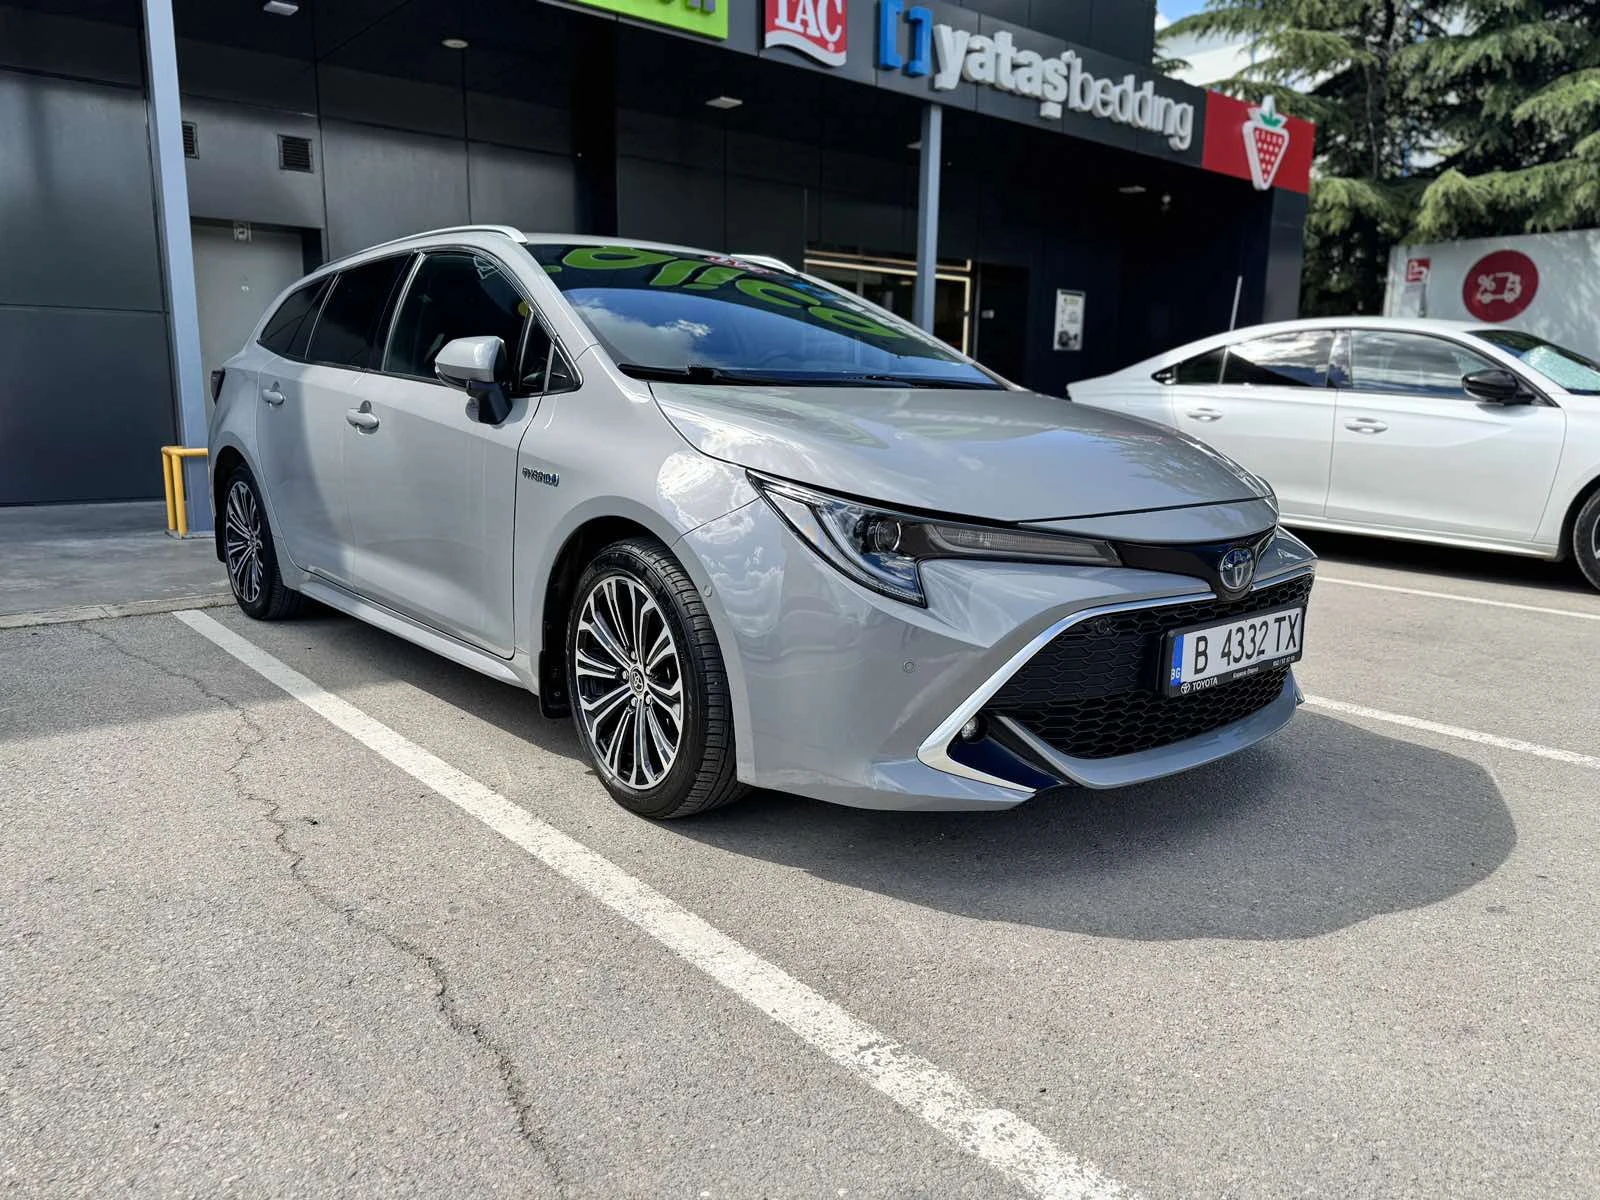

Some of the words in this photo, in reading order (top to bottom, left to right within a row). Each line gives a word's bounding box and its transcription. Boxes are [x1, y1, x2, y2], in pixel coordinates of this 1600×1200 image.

[1193, 635, 1209, 675] B
[1220, 620, 1269, 667] 4332
[1274, 613, 1300, 652] TX
[1170, 667, 1181, 680] BG
[1192, 677, 1218, 692] TOYOTA
